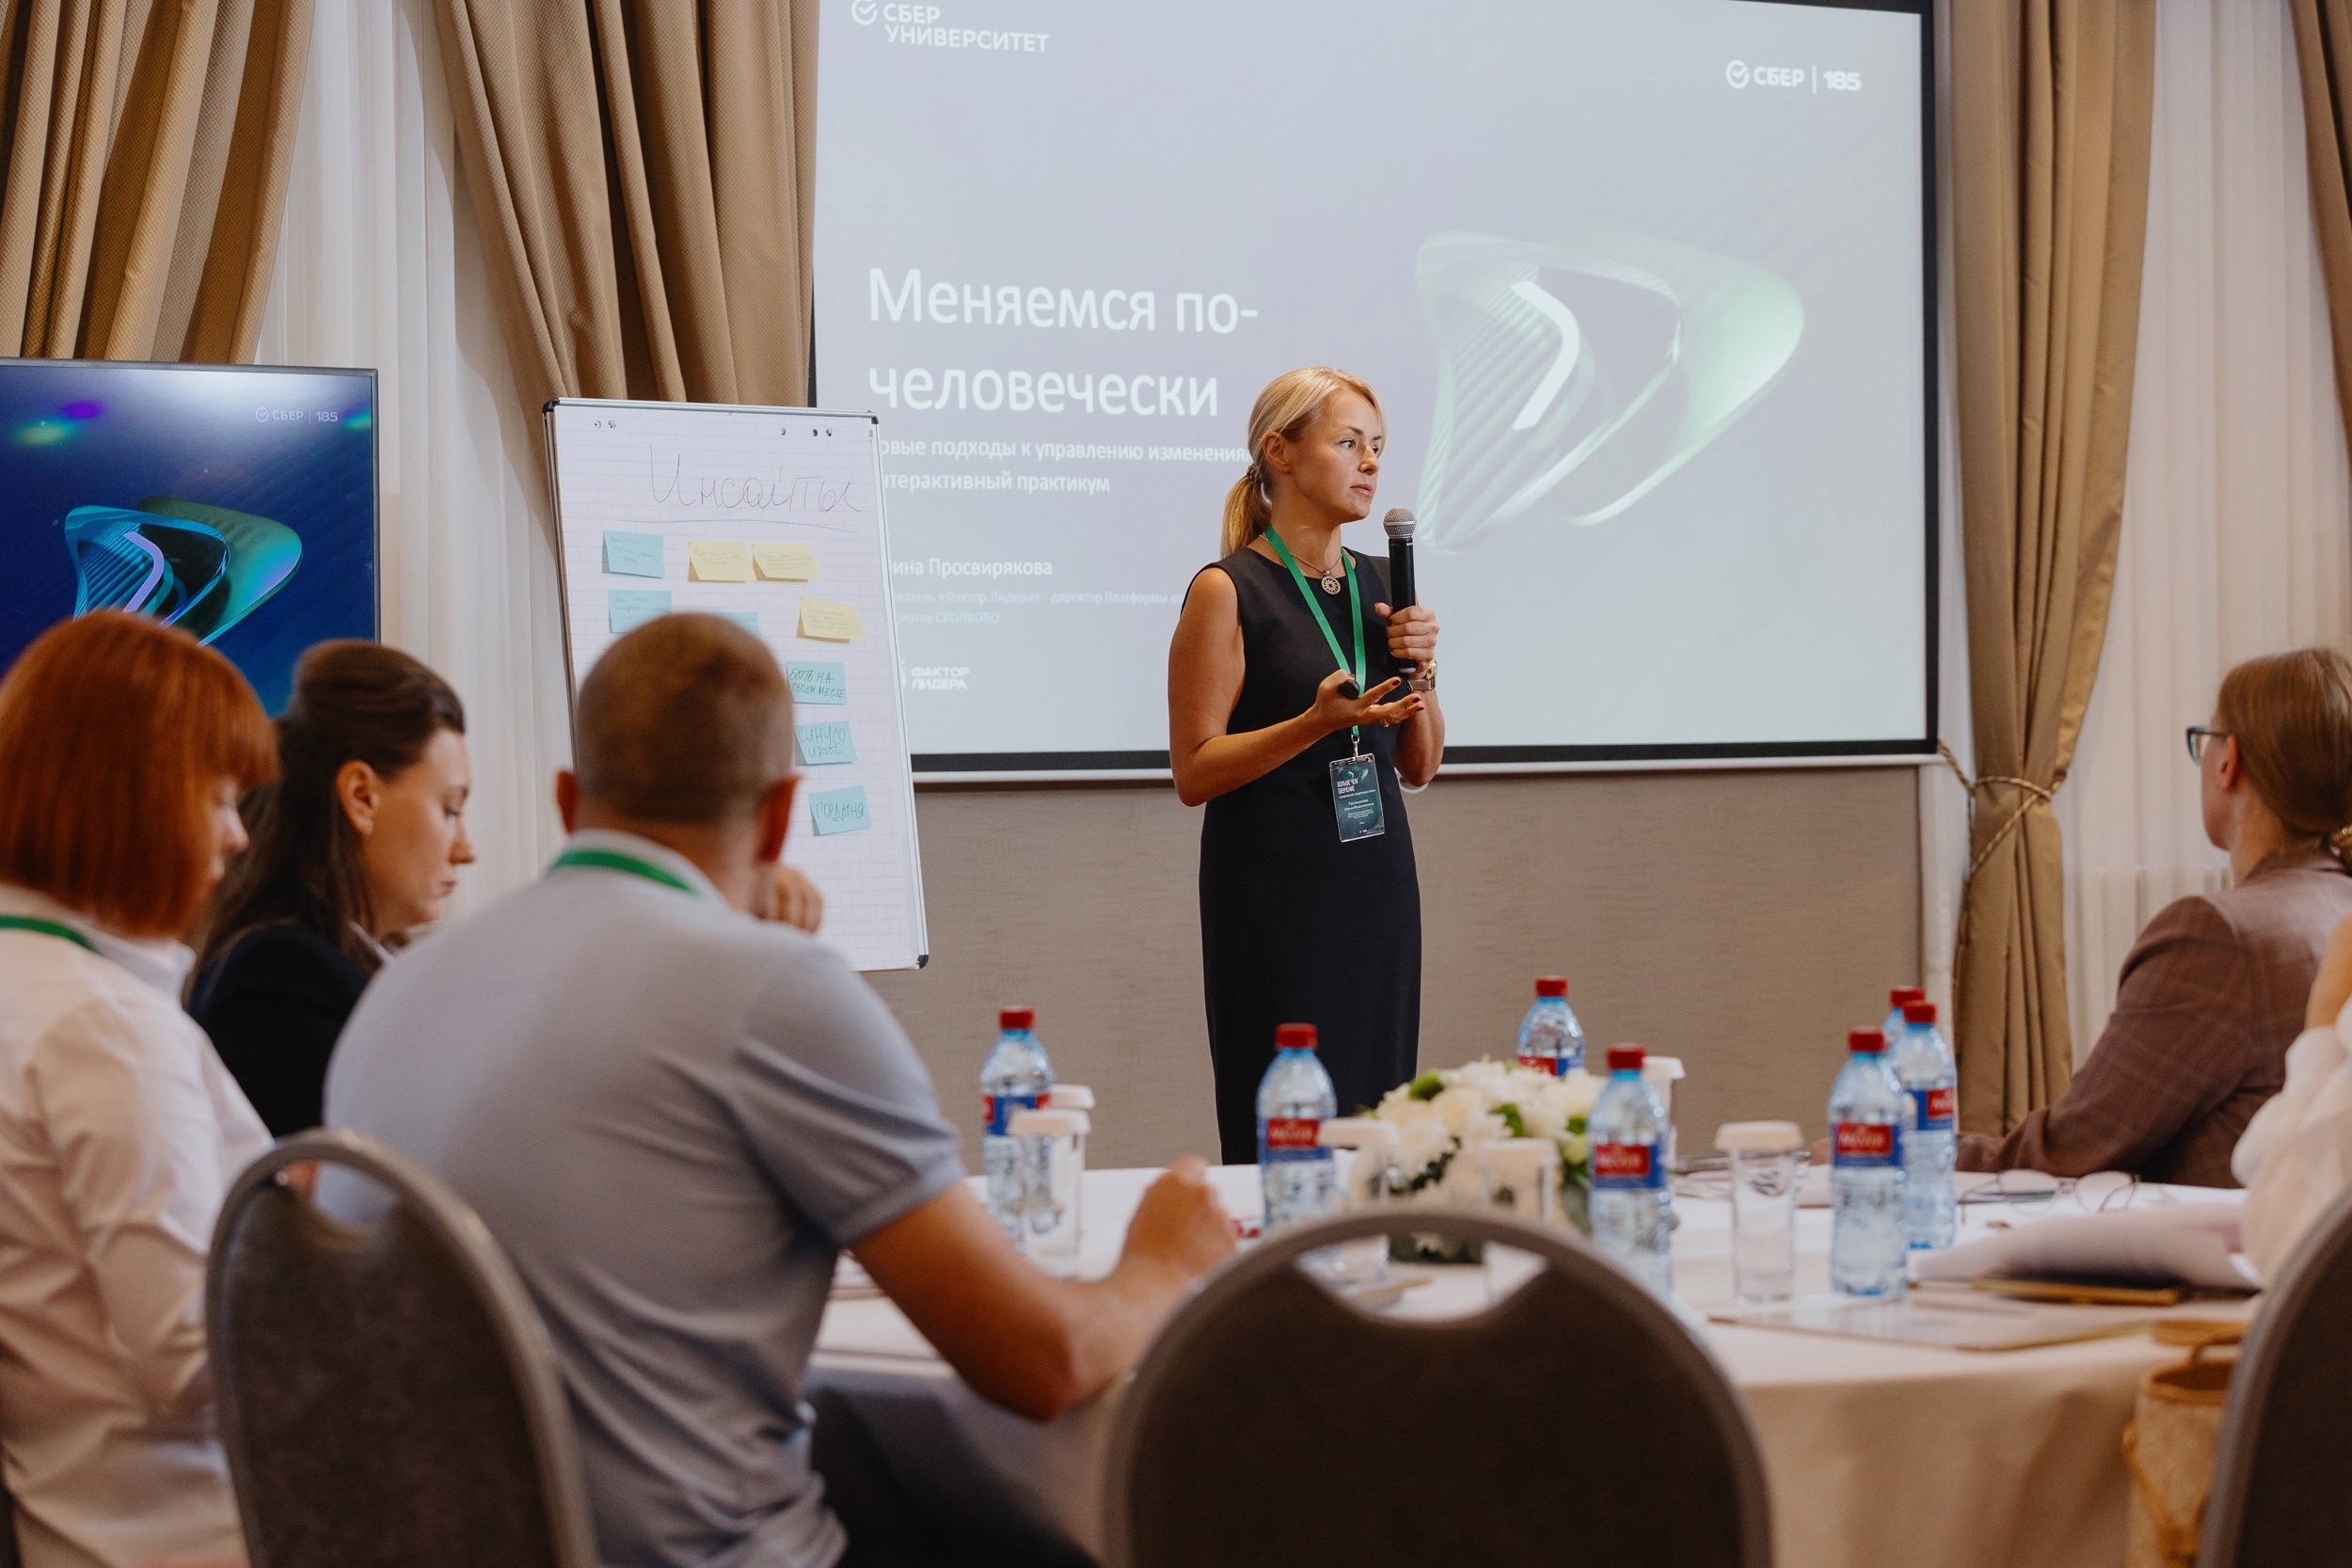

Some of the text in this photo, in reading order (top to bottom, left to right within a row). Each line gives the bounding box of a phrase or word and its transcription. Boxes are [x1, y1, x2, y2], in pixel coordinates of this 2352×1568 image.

[882, 2, 941, 25] СБЕР
[884, 24, 1050, 53] УНИВЕРСИТЕТ
[1753, 65, 1863, 92] СБЕР 185
[868, 266, 1259, 334] Меняемся по-
[867, 366, 1219, 418] человечески
[272, 409, 339, 423] СБЕР 185
[880, 439, 927, 456] овые
[931, 440, 1017, 461] подходы
[1021, 442, 1032, 457] к
[1035, 442, 1145, 463] управлению
[648, 444, 862, 514] Инсайты
[883, 469, 1111, 497] терактивный практикум
[890, 557, 1053, 580] ина Просвирякова
[1049, 593, 1104, 606] директор
[1104, 591, 1168, 606] Платформы
[896, 611, 1000, 625] циатив СКОЛКОВО
[911, 666, 971, 678] ФАКТОР
[818, 685, 847, 698] МЕСТЕ
[911, 678, 968, 690] ЛИДЕРА
[816, 801, 865, 822] ГОРДЫНЯ
